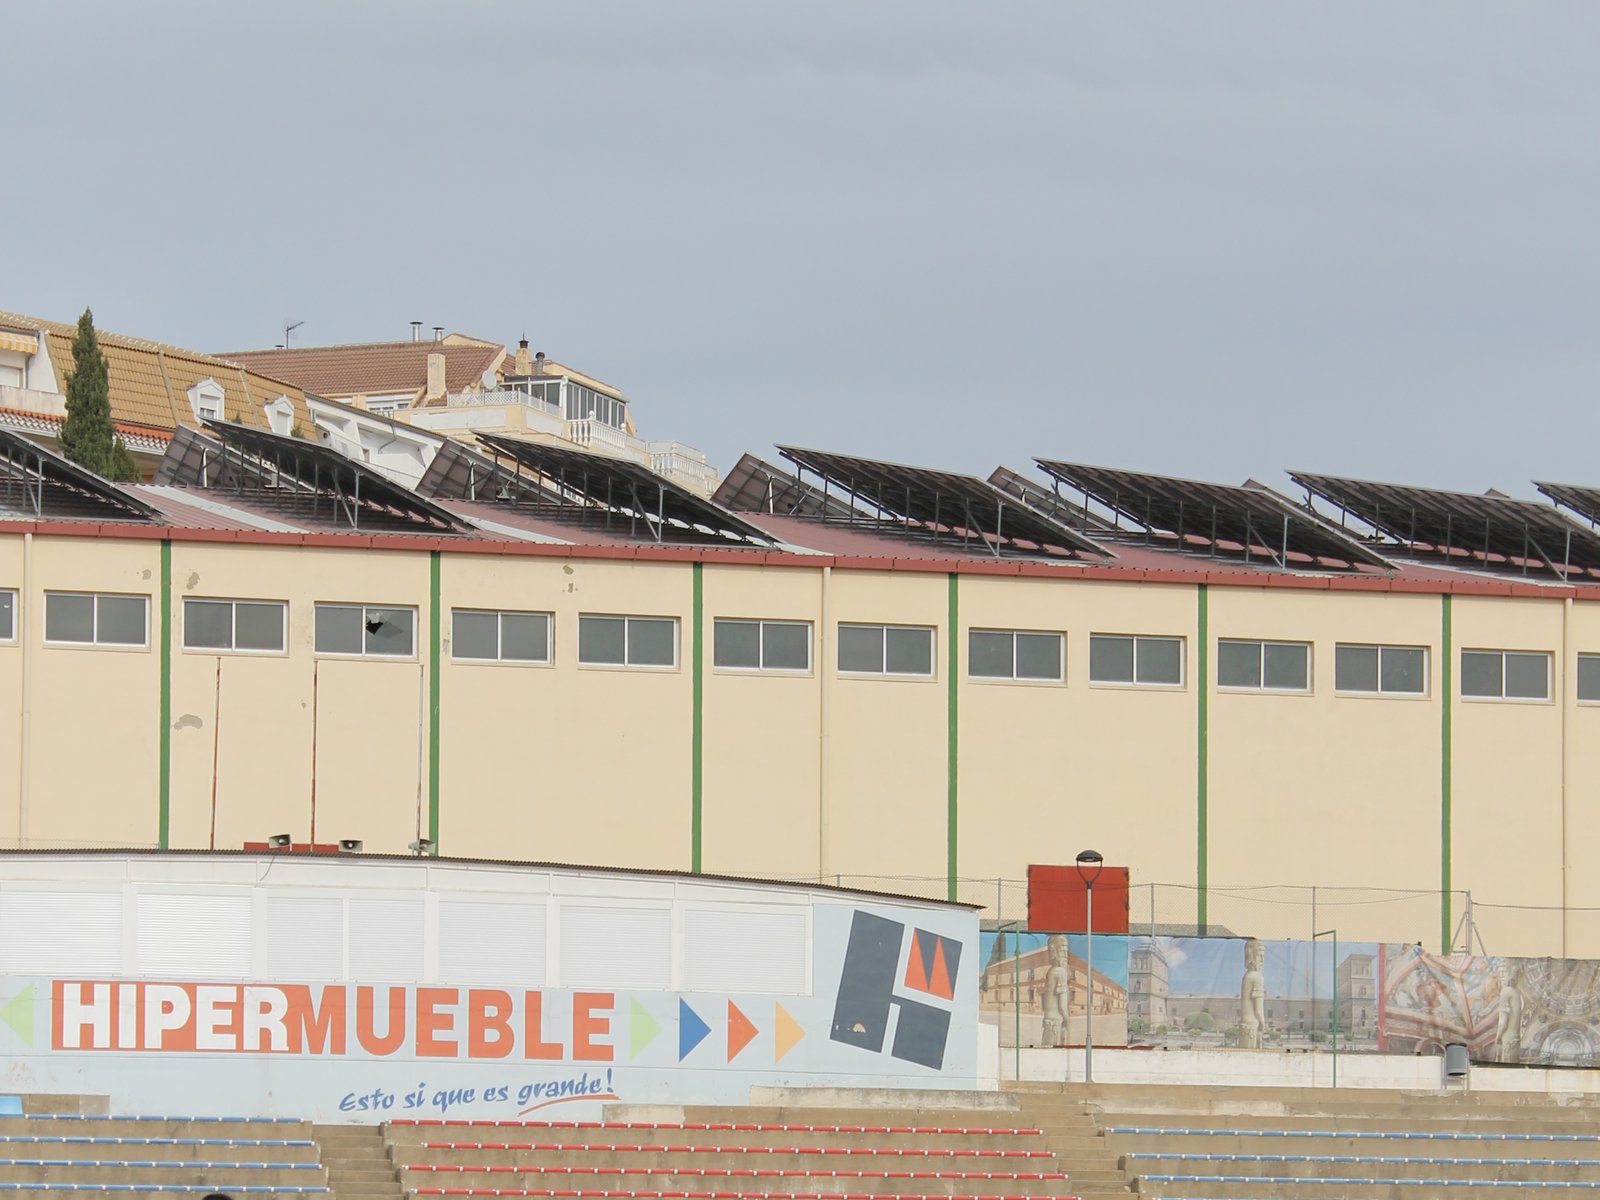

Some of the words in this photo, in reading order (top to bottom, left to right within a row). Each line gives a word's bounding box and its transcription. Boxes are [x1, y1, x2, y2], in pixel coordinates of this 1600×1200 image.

[62, 983, 614, 1061] HIPERMUEBLE
[338, 1088, 395, 1112] Esto
[403, 1082, 426, 1109] si
[432, 1086, 476, 1113] que
[483, 1084, 508, 1102] es
[517, 1068, 614, 1105] grande!
